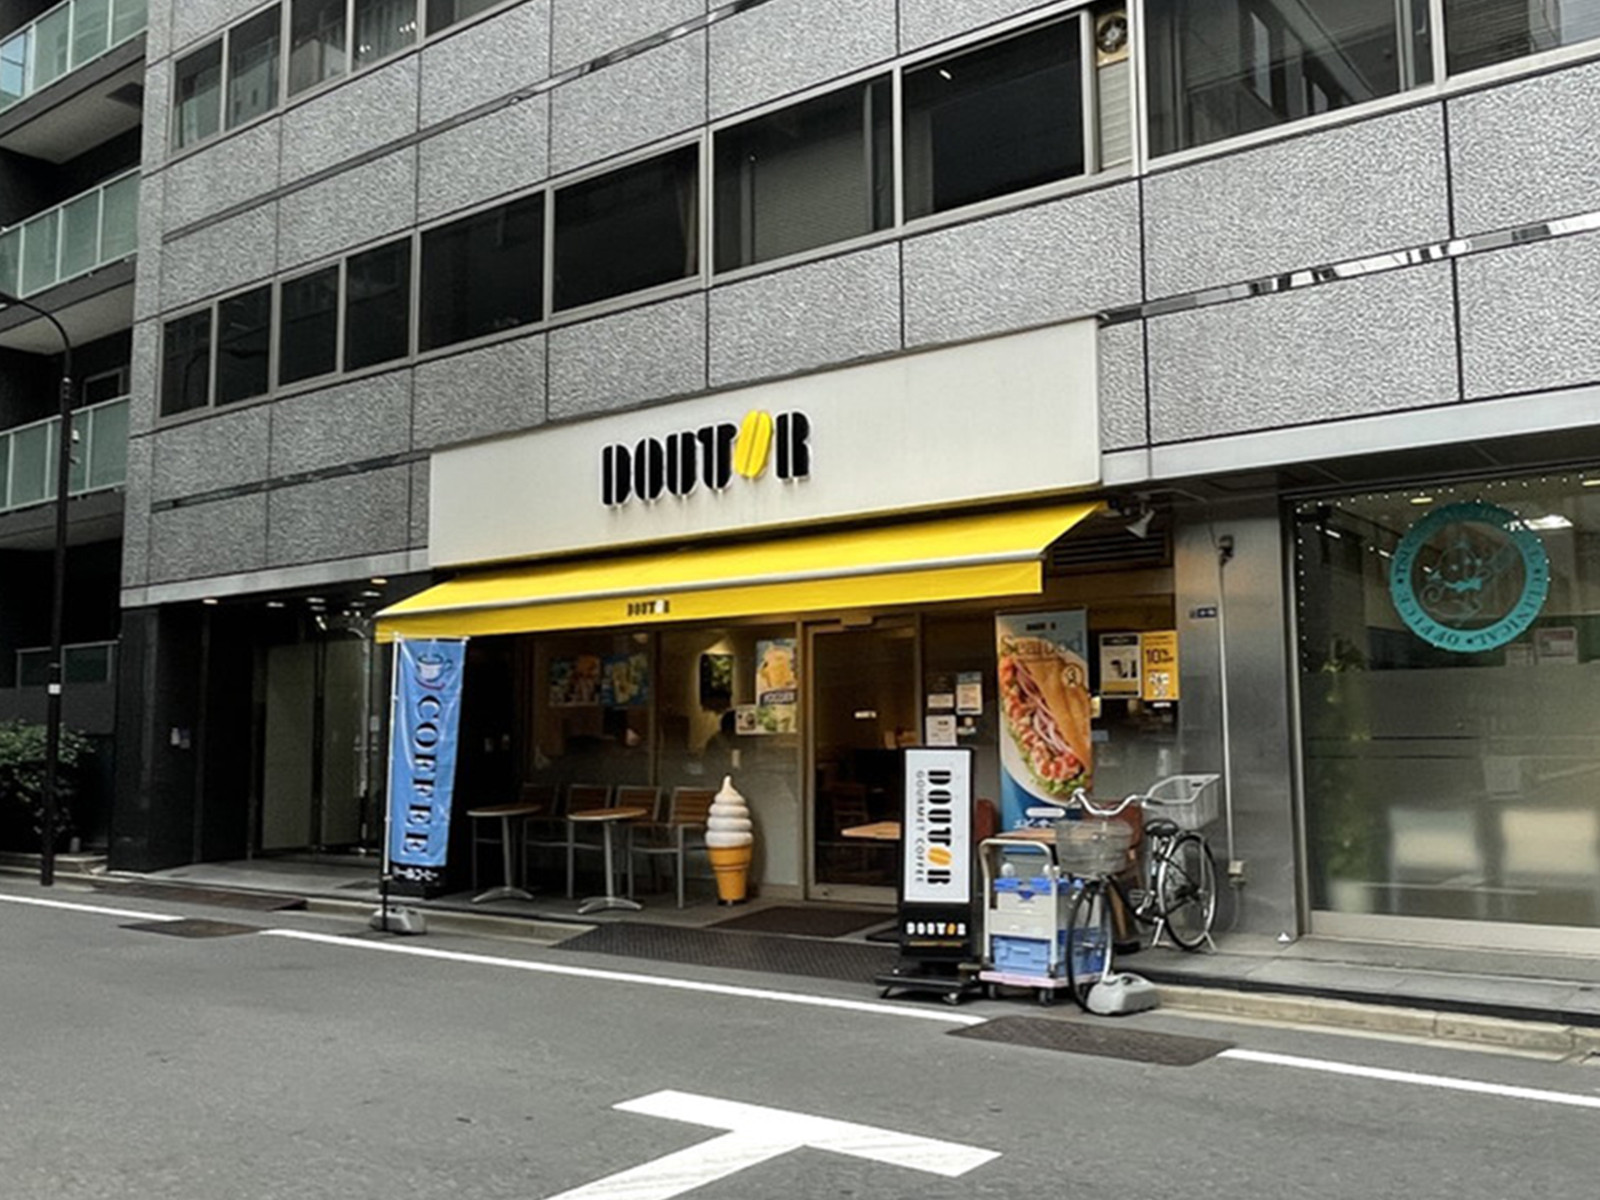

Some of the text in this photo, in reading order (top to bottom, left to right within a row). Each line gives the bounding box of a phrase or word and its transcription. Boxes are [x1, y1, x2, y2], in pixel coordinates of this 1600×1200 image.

[403, 695, 442, 854] COFFEE
[915, 770, 926, 882] GOURMET COFFEE
